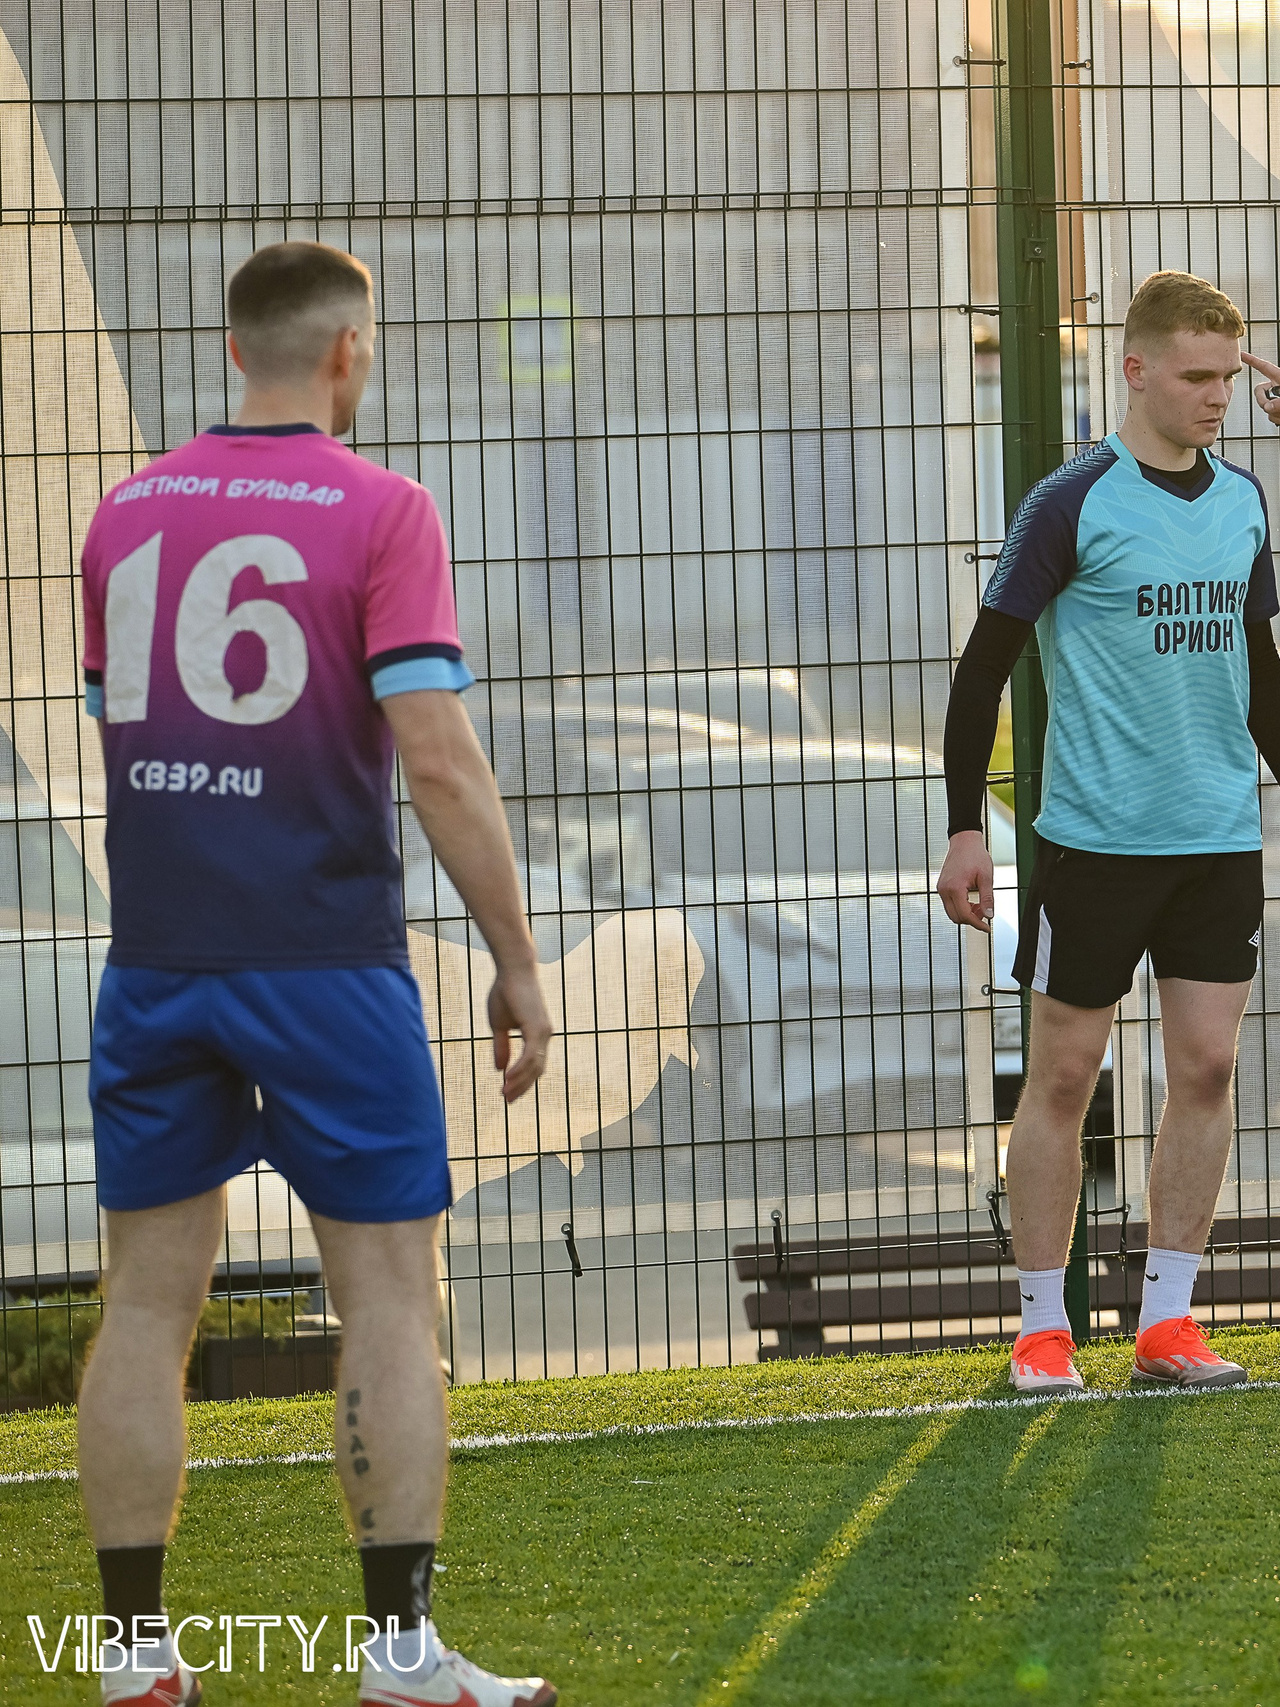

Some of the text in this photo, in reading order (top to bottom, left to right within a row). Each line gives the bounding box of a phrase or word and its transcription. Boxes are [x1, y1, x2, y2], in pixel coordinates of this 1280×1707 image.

[226, 478, 345, 506] БУЛЬВАР
[105, 531, 309, 725] 16
[1154, 618, 1234, 655] ОРИОН
[129, 761, 264, 797] CB39.RU
